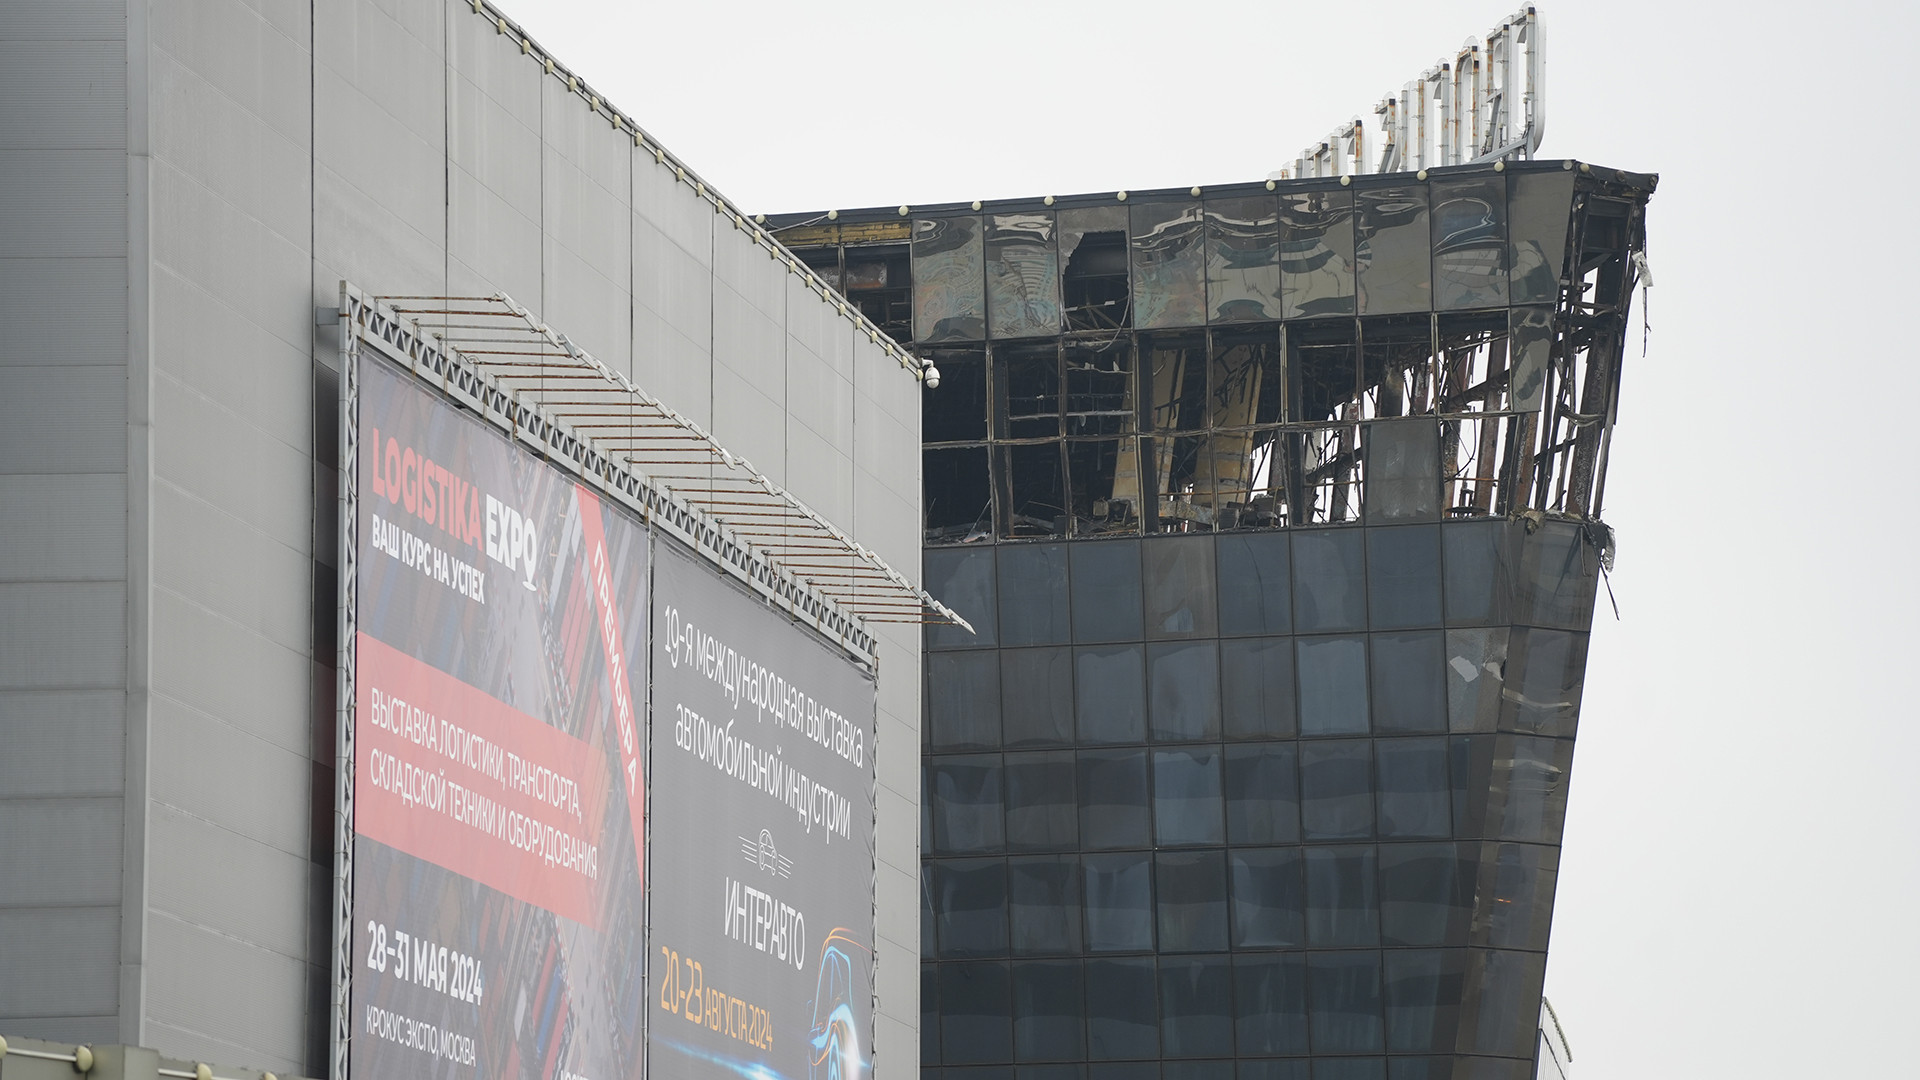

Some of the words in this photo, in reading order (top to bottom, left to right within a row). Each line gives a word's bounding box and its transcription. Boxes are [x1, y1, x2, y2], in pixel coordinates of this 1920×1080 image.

[372, 428, 483, 551] LOGISTIKA
[486, 493, 538, 591] EXPO
[372, 513, 400, 560] ВАШ
[402, 529, 431, 576] КУРС
[434, 547, 450, 587] НА
[451, 556, 485, 604] УСПЕХ
[594, 539, 637, 797] ПРЕМЬЕРА
[664, 605, 693, 668] 19-я
[696, 628, 804, 733] международная
[806, 696, 863, 769] выставка
[370, 748, 446, 814] СКЛАДСКОЙ
[448, 781, 496, 837] ТЕХНИКИ
[498, 804, 506, 841] И
[508, 810, 598, 881] ОБОРУДОВАНИЯ
[371, 687, 438, 752] ВЫСТАВКА
[439, 719, 506, 791] ЛОГИСТИКИ,
[507, 752, 582, 825] ТРАНСПОРТА,
[675, 702, 783, 800] автомобильной
[785, 764, 851, 845] индустрии
[414, 937, 448, 994] МАЯ
[450, 950, 483, 1006] 2024
[724, 876, 805, 971] ИНТЕРАВТО
[366, 1004, 405, 1045] КРОКУС
[405, 1016, 440, 1061] ЭКСПО,
[440, 1032, 477, 1067] МОСКВА
[660, 945, 703, 1025] 20-23
[704, 986, 748, 1041] АВГУСТА
[749, 1004, 773, 1051] 2024
